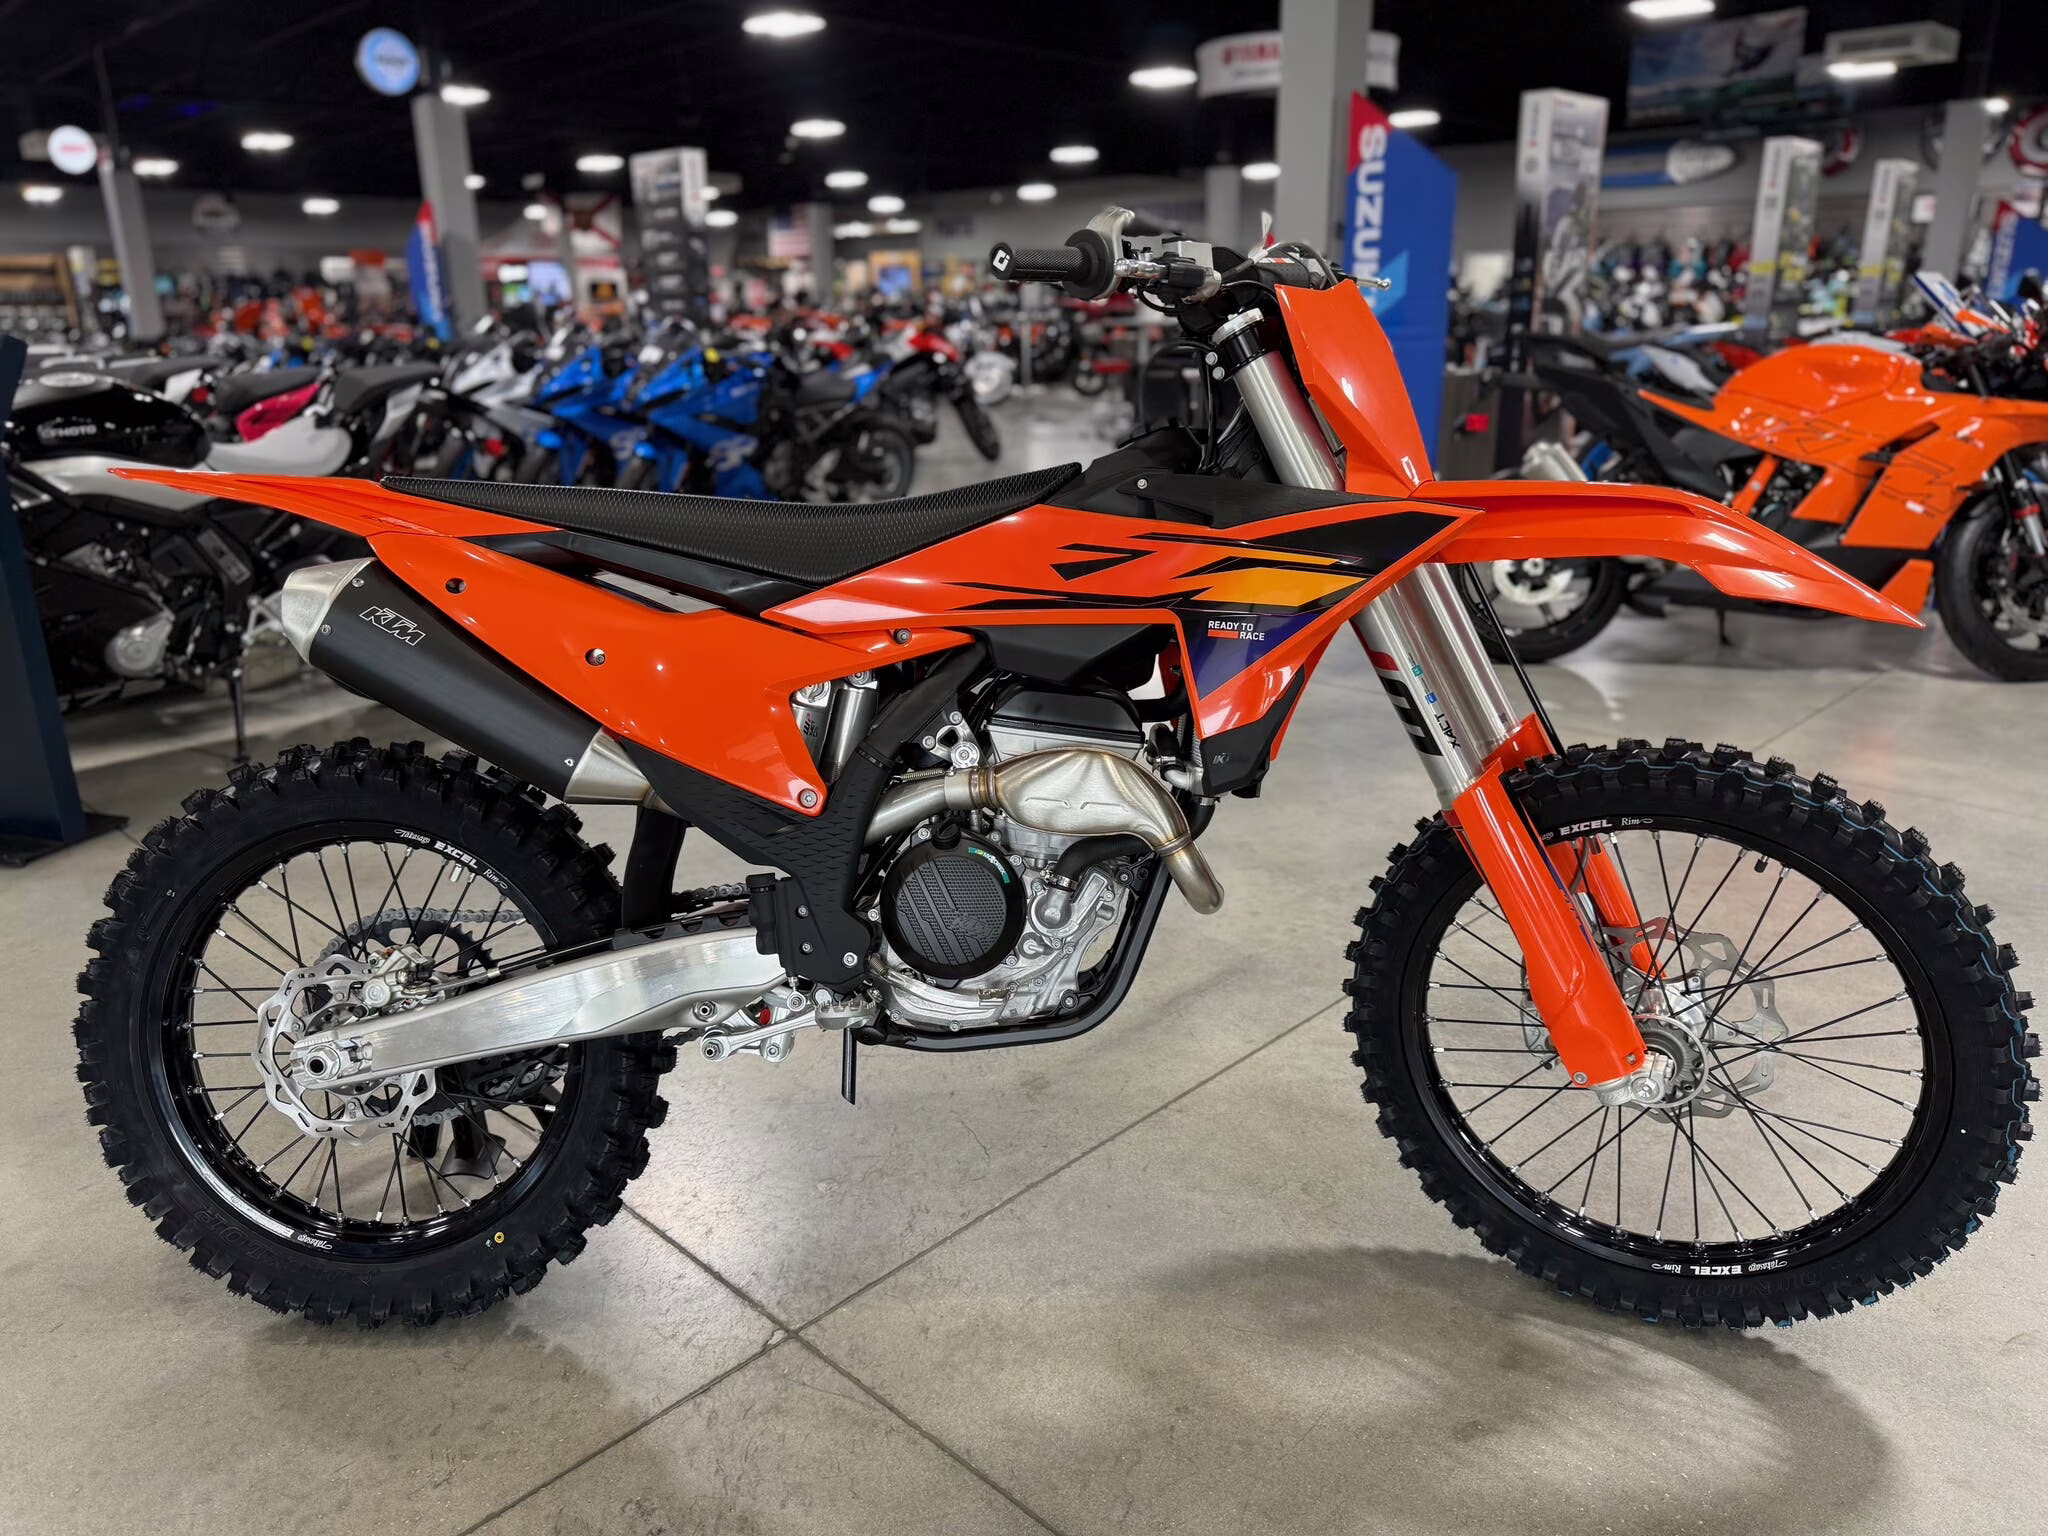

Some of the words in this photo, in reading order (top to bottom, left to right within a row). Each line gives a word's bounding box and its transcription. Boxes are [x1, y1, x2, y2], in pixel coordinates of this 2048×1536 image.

[359, 605, 426, 646] KTM
[1208, 620, 1240, 630] READY
[1241, 622, 1254, 632] TO
[1240, 631, 1265, 641] RACE
[1434, 713, 1461, 749] XACT
[1559, 819, 1613, 836] EXCEL
[1621, 817, 1654, 826] Rim
[434, 840, 478, 868] EXCEL
[483, 868, 508, 889] Rim
[1651, 1263, 1682, 1274] Rim
[1690, 1265, 1743, 1276] EXCEL
